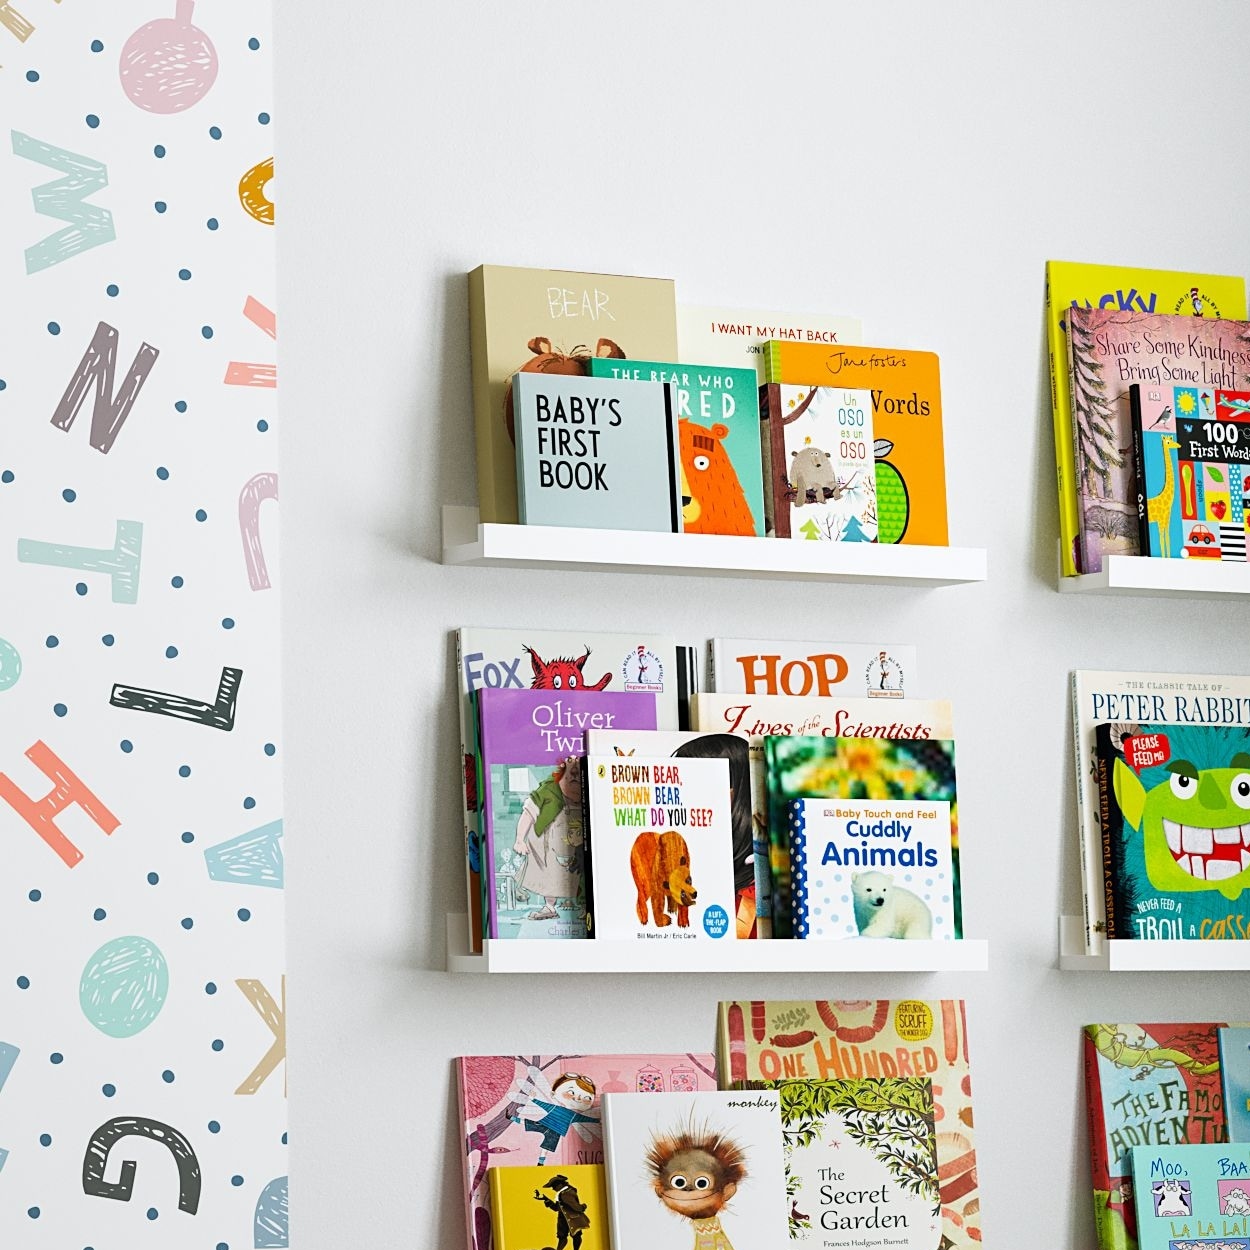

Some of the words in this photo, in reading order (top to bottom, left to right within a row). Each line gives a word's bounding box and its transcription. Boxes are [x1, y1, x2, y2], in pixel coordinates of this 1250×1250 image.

[547, 287, 616, 321] BEAR
[718, 323, 752, 337] WANT
[756, 326, 778, 338] MY
[779, 328, 803, 340] HAT
[806, 330, 838, 343] BACK
[1096, 333, 1140, 356] Share
[1146, 333, 1185, 357] Some
[826, 352, 867, 374] Jane
[1117, 358, 1160, 386] Bring
[1162, 356, 1199, 382] Some
[1202, 361, 1238, 390] Light
[698, 374, 734, 388] WHO
[842, 392, 857, 407] Un
[536, 394, 622, 427] BABY'S
[838, 408, 864, 426] OSO
[538, 427, 600, 458] FIRST
[1202, 422, 1239, 444] 100
[840, 441, 866, 460] OSO
[1189, 440, 1219, 459] First
[539, 460, 609, 491] BOOK
[736, 654, 849, 697] HOP
[1146, 682, 1184, 690] CLASSIC
[1186, 683, 1208, 691] TALE
[532, 701, 616, 728] Oliver
[1092, 693, 1168, 722] PETER
[822, 710, 932, 740] Scientists
[1132, 735, 1160, 751] PLEASE
[1133, 751, 1153, 766] FEED
[611, 765, 650, 783] BROWN
[653, 766, 683, 785] BEAR,
[613, 786, 650, 805] BROWN
[655, 787, 683, 805] BEAR,
[614, 808, 646, 827] WHAT
[651, 808, 665, 826] DO
[667, 808, 687, 827] YOU
[690, 809, 713, 827] SEE?
[836, 809, 861, 819] Baby
[864, 809, 893, 819] Touch
[895, 809, 913, 819] and
[917, 809, 937, 819] Feel
[846, 820, 912, 842] Cuddly
[821, 841, 938, 867] Animals
[1160, 898, 1175, 911] FEED
[1190, 925, 1196, 937] A
[899, 1014, 928, 1030] SCRUFF
[759, 1049, 809, 1080] ONE
[813, 1036, 938, 1079] HUNDRED
[727, 1096, 777, 1112] monkey
[1112, 1090, 1155, 1122] THE
[818, 1167, 845, 1182] The
[820, 1184, 889, 1205] Secret
[820, 1205, 909, 1231] Garden
[1170, 1220, 1190, 1238] LA
[1197, 1220, 1215, 1237] LA
